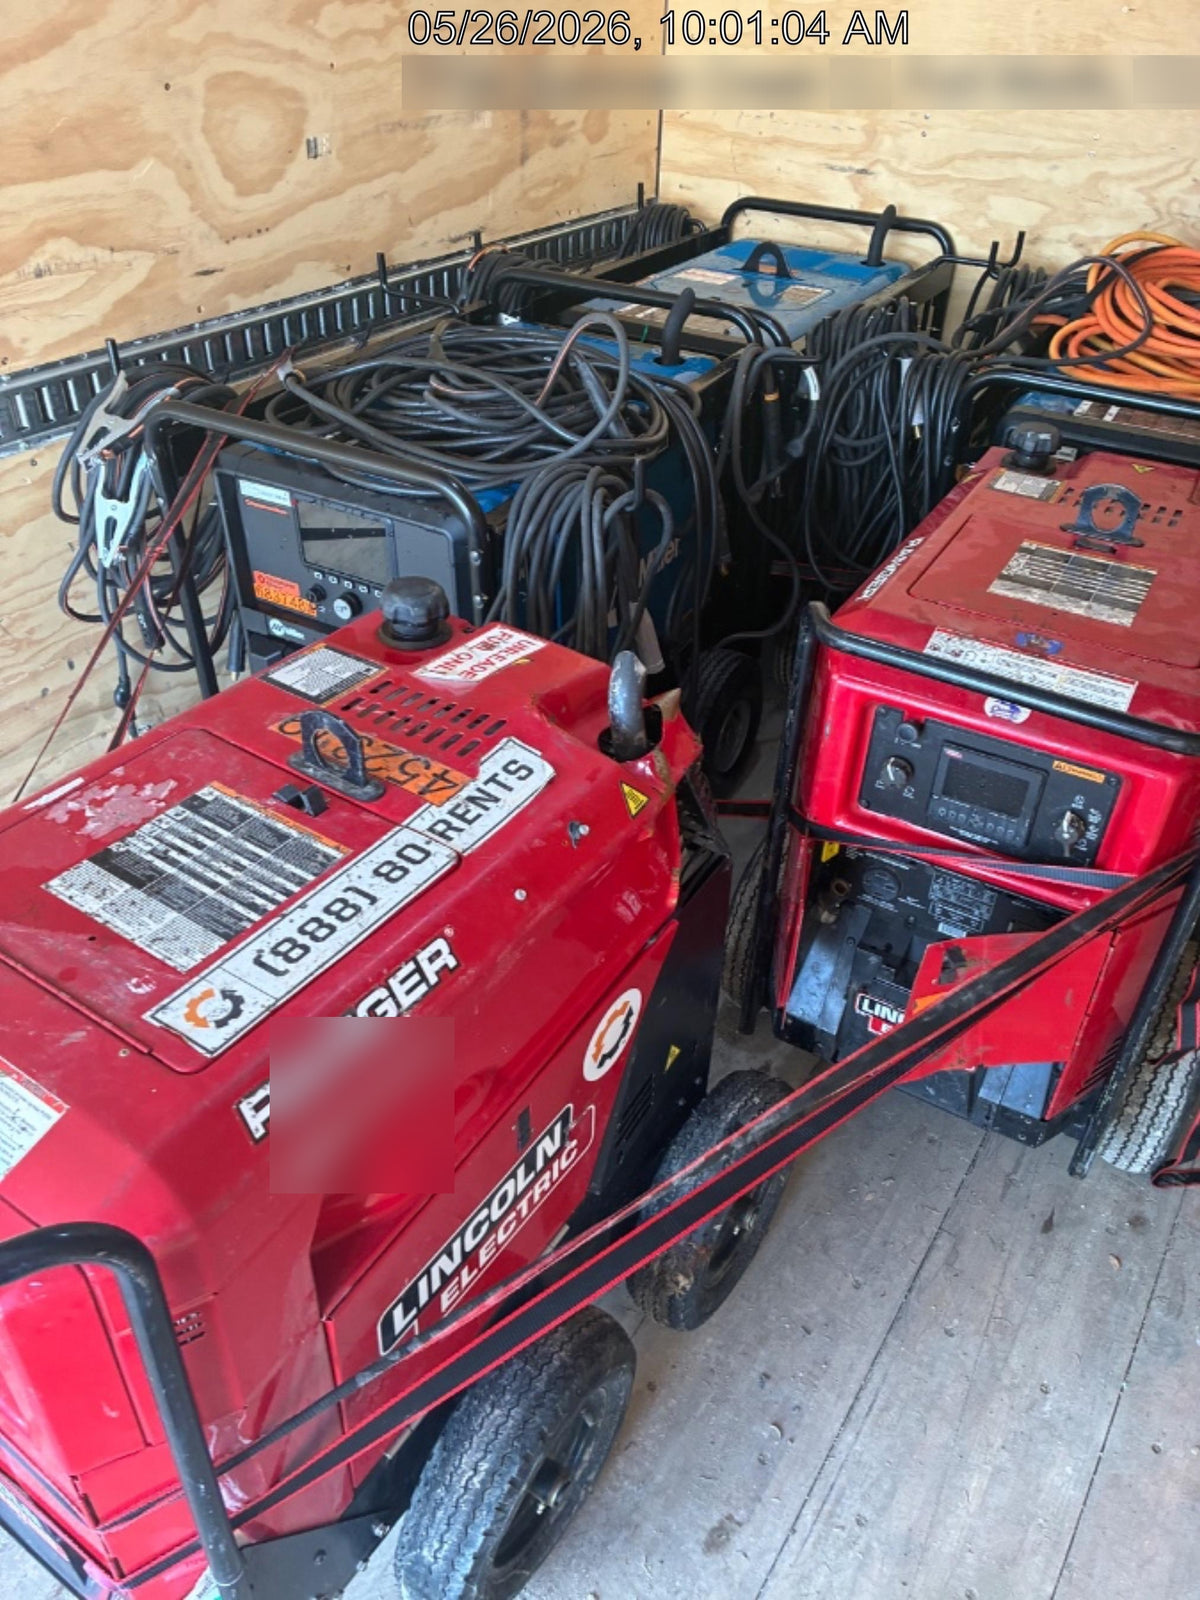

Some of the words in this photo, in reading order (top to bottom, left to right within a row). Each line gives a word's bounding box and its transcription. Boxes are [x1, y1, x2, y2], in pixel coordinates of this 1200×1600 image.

[252, 886, 379, 977] (888)
[391, 1120, 564, 1337] LINCOLN
[439, 1141, 580, 1313] ELECTRIC
